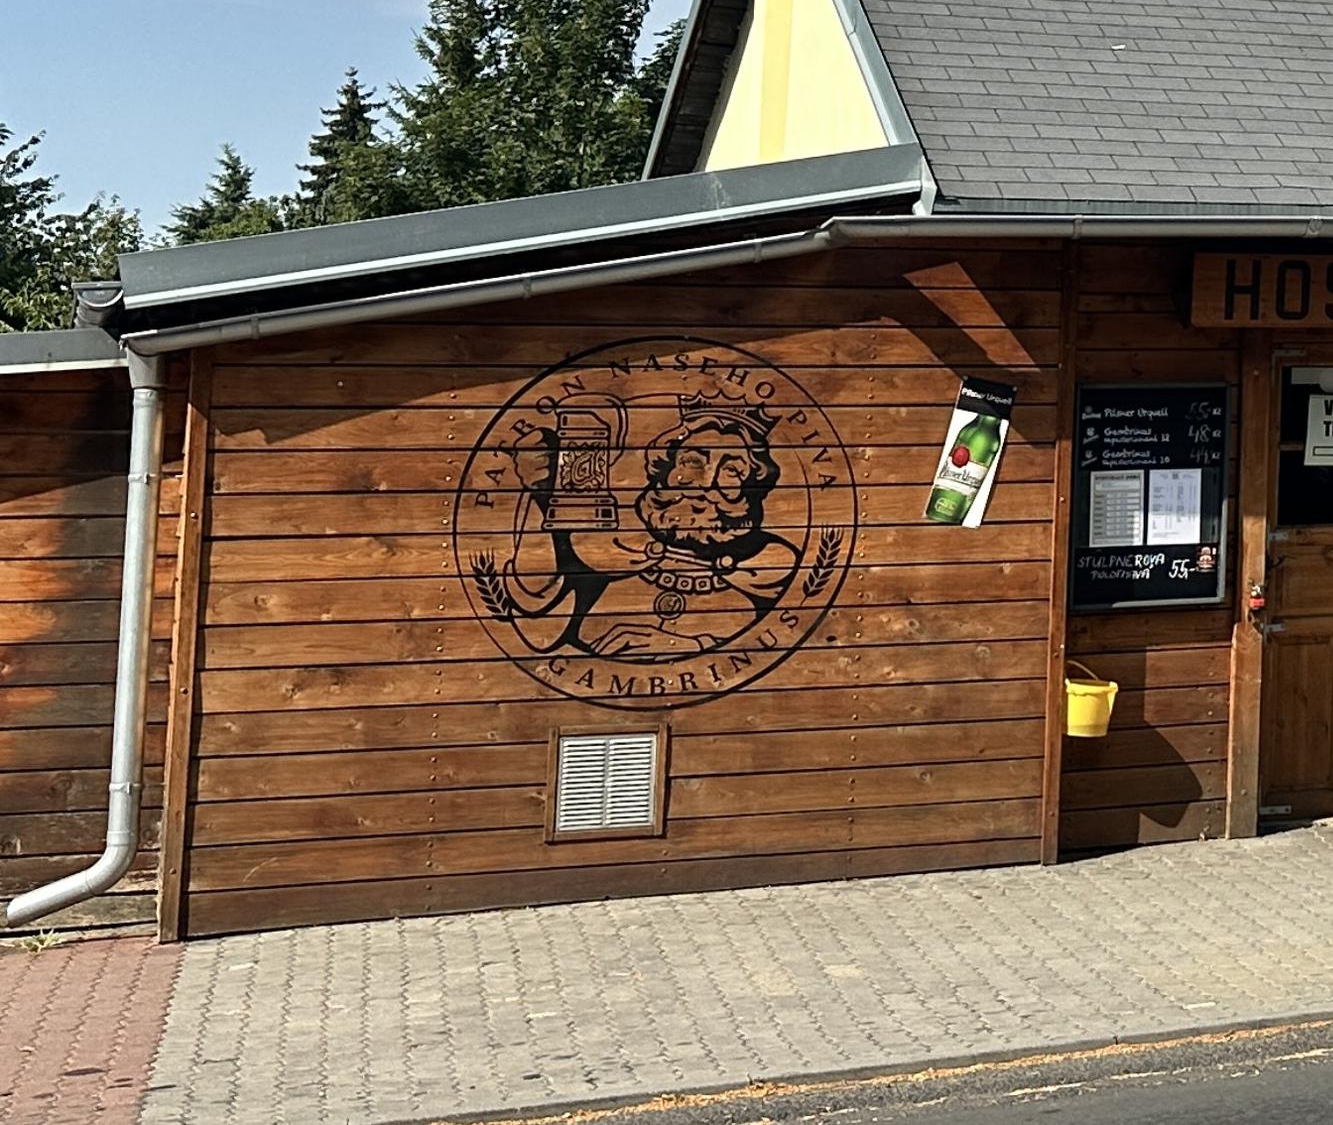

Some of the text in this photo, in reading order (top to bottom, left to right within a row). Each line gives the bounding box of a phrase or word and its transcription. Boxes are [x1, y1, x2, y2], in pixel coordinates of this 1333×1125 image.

[474, 375, 588, 509] PATRON
[786, 410, 839, 492] PIVA
[549, 608, 802, 695] GAMBRINUS
